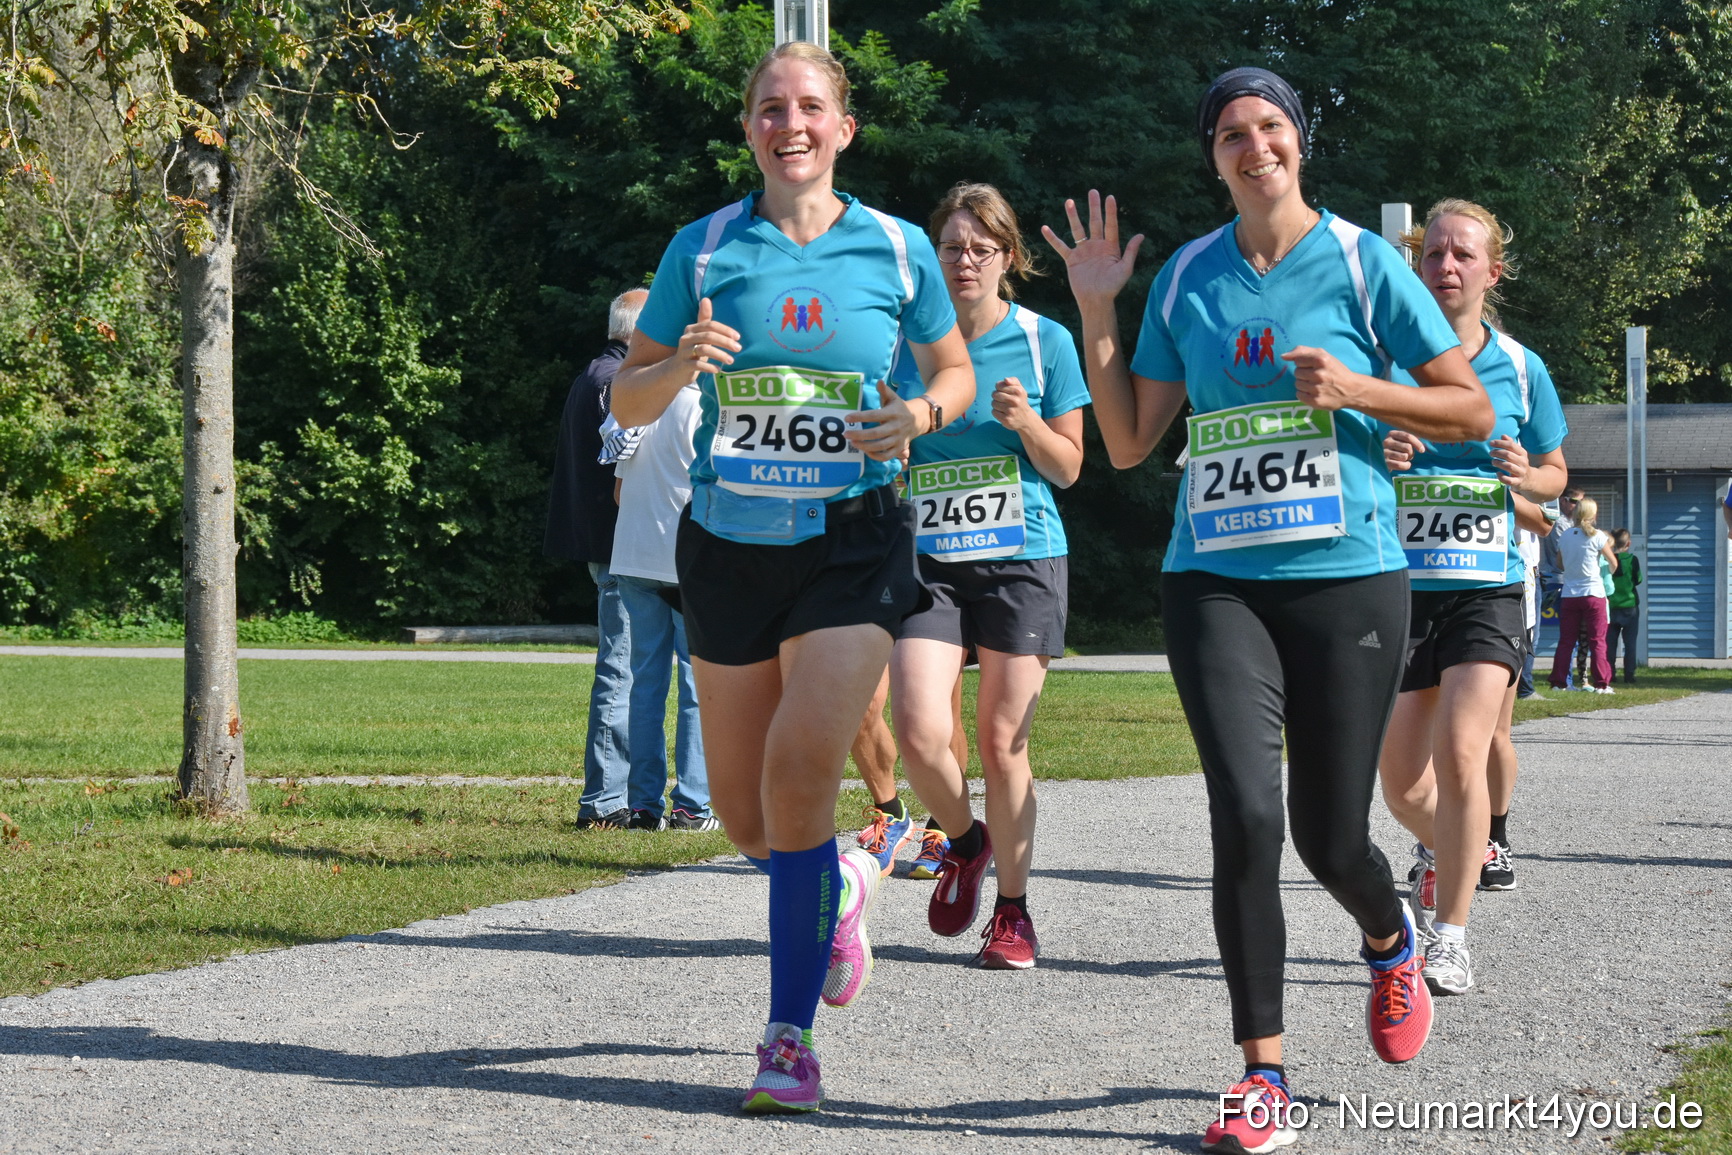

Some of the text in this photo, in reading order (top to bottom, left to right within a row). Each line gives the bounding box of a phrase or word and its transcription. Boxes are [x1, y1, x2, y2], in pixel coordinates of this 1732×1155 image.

[727, 373, 848, 404] BOCK
[731, 414, 846, 453] 2468
[1198, 406, 1321, 451] BOCK
[751, 464, 820, 483] KATHI
[917, 461, 1007, 492] BOCK
[1203, 449, 1320, 502] 2464
[1402, 480, 1498, 506] BOCK
[921, 492, 1007, 528] 2467
[1214, 504, 1314, 533] KERSTIN
[935, 533, 999, 551] MARGA
[1406, 512, 1495, 544] 2469
[1423, 553, 1477, 567] KATHI
[817, 870, 831, 942] under pressure
